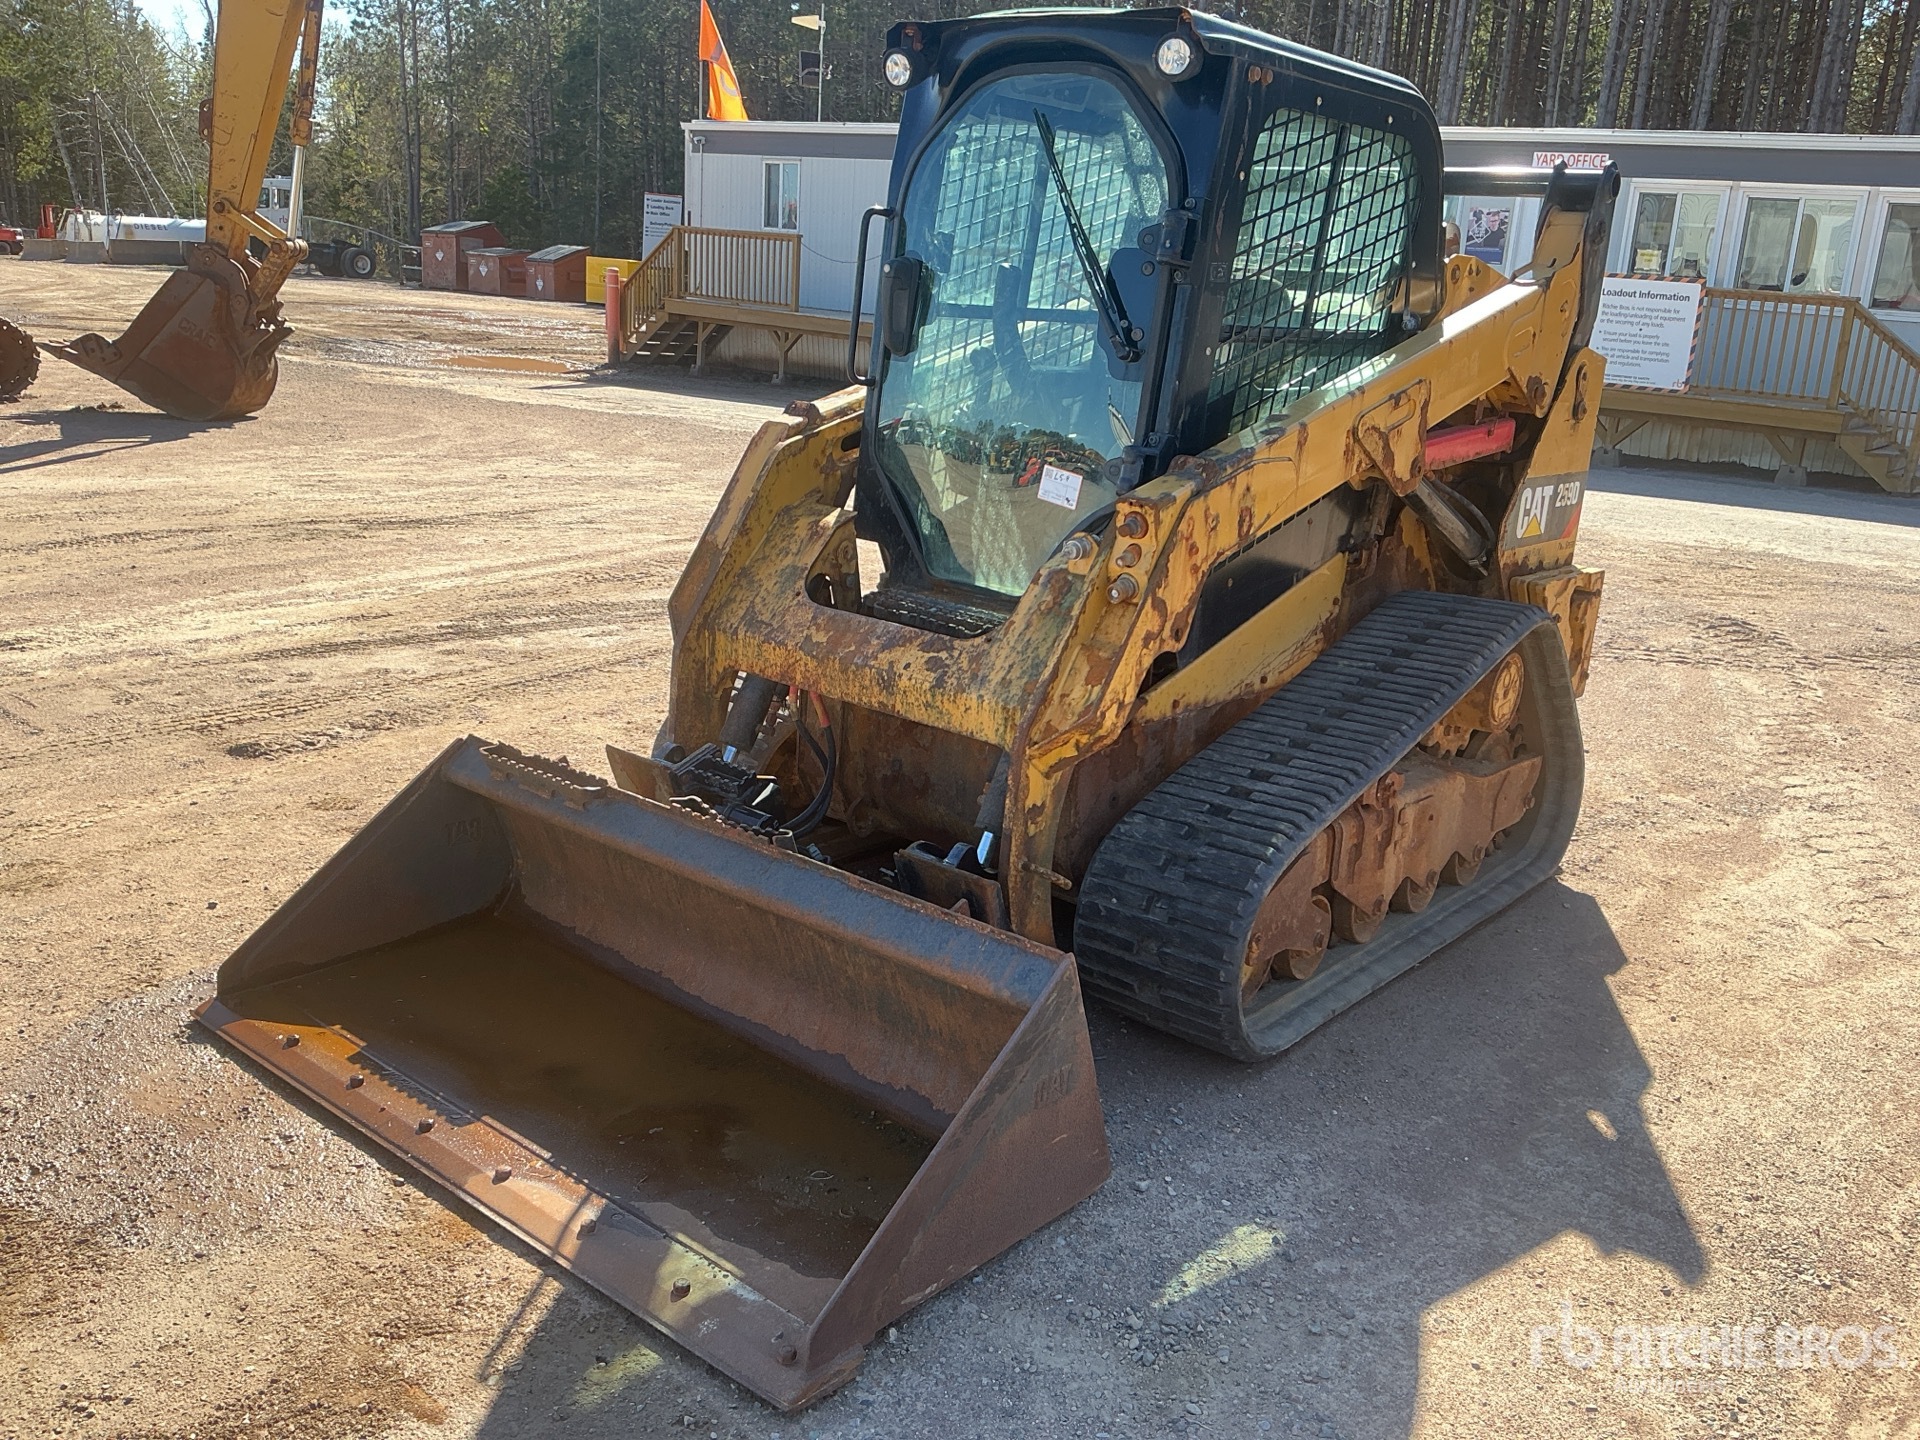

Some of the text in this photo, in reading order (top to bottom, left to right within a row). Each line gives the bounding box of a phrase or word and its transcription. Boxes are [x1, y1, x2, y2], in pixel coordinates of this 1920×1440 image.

[1567, 154, 1607, 168] OFFICE
[133, 223, 169, 231] DIESEL
[1602, 288, 1691, 302] Loadout Information
[1645, 306, 1672, 314] responsible
[1615, 319, 1634, 327] securing
[1660, 315, 1686, 323] equipment
[1516, 481, 1581, 539] CAT 259D
